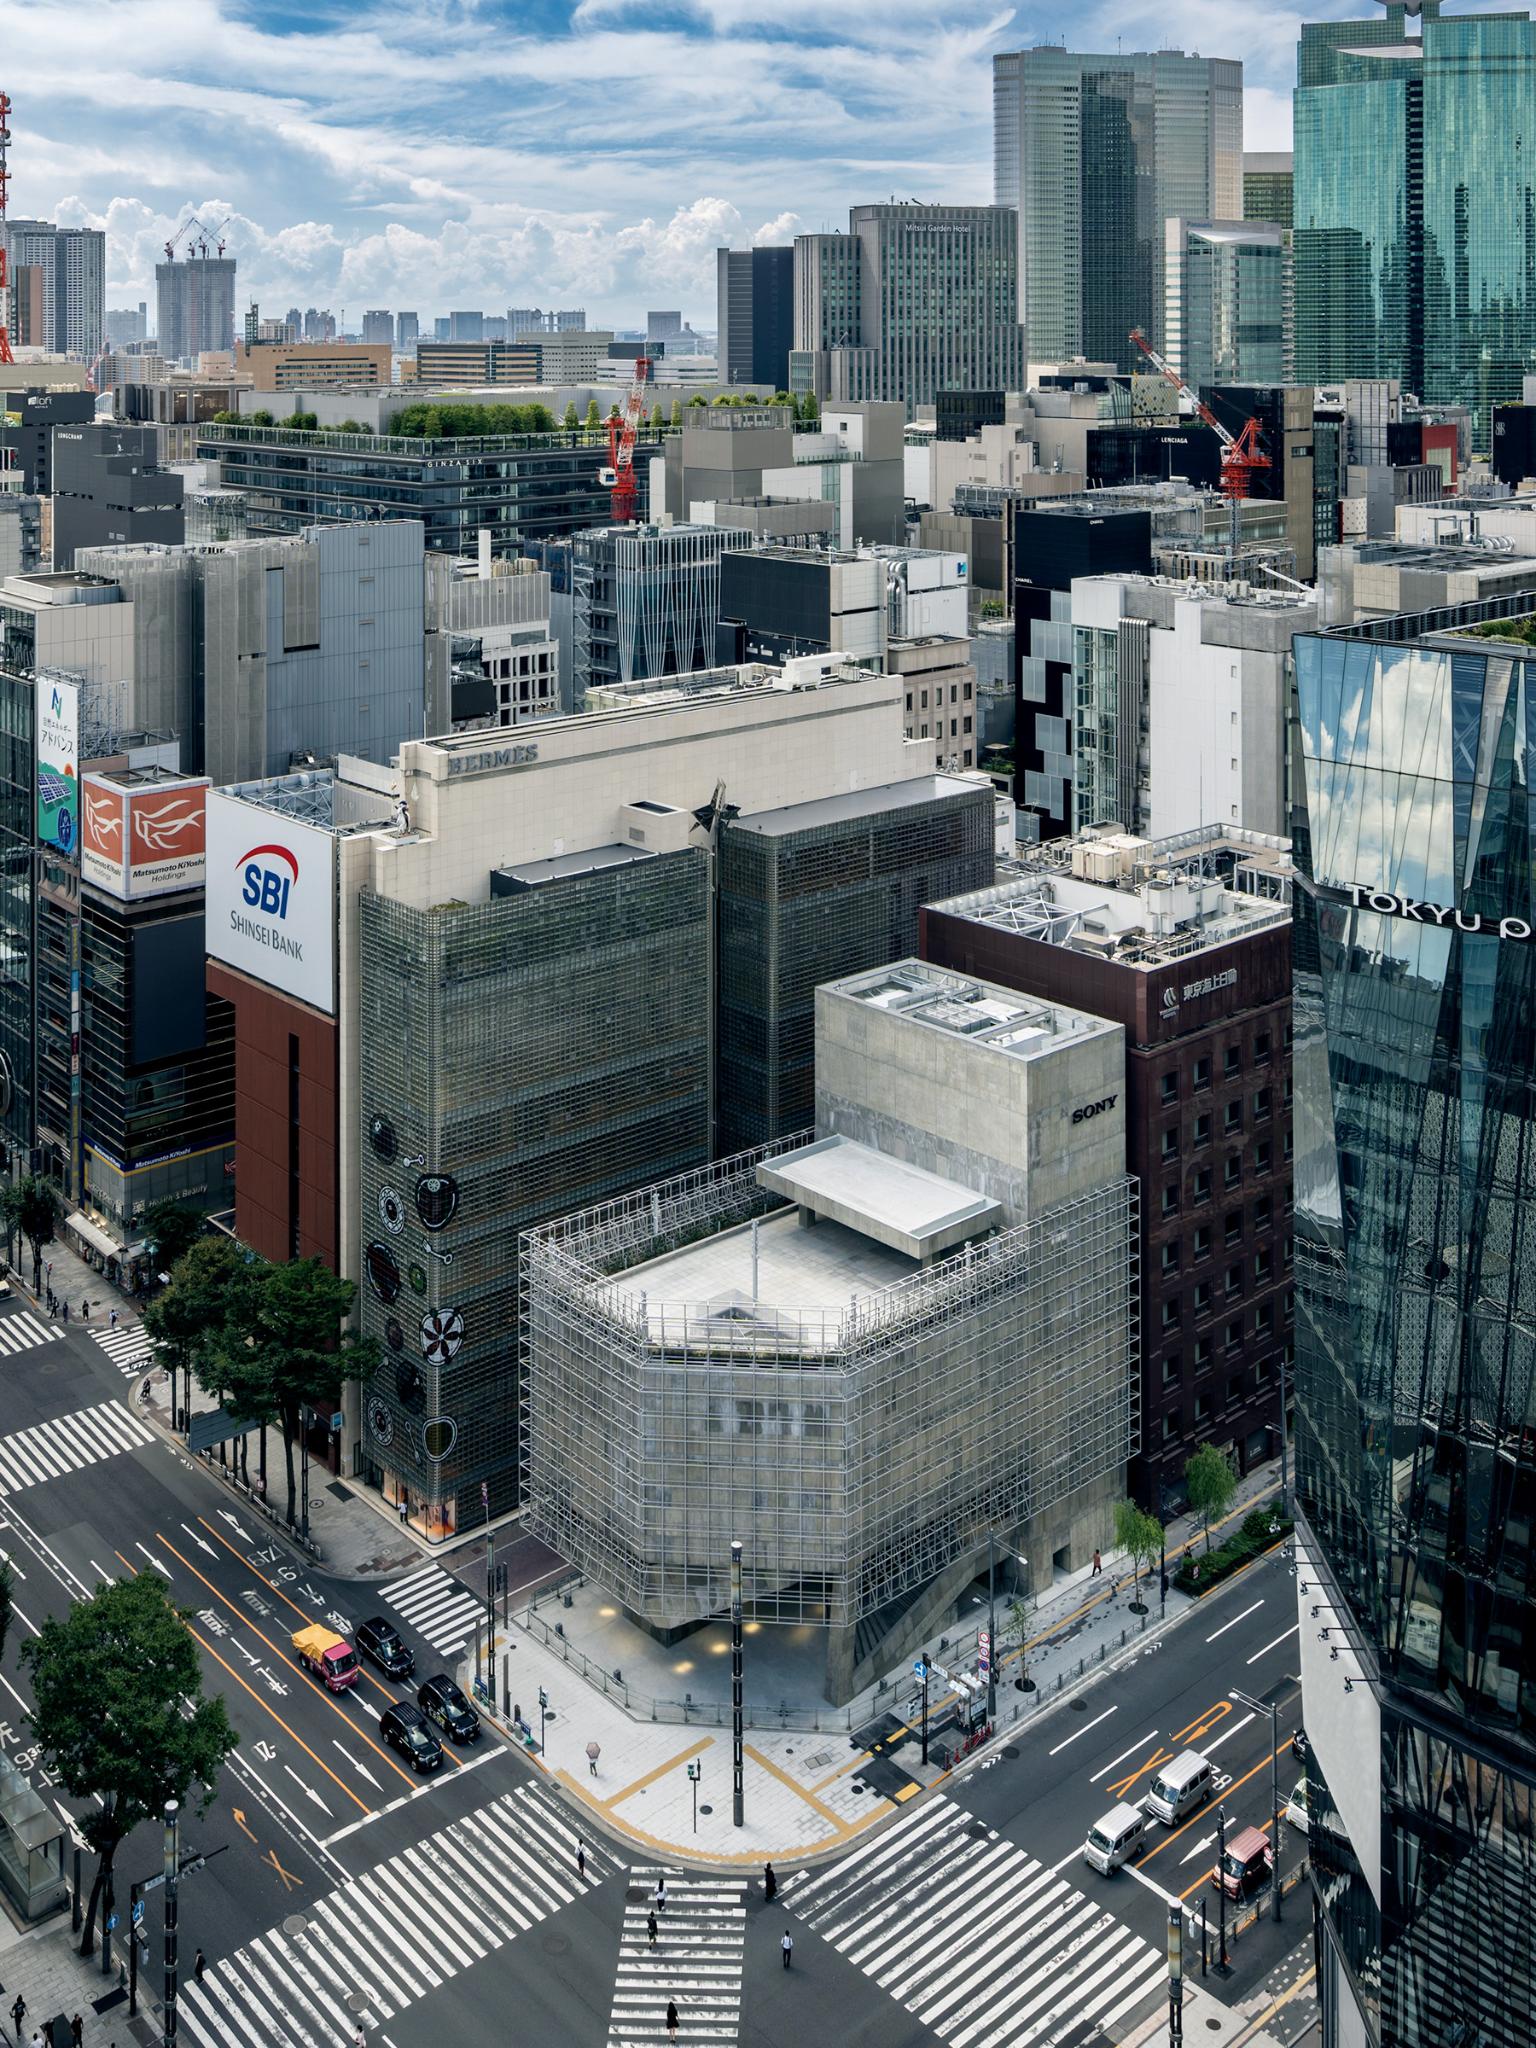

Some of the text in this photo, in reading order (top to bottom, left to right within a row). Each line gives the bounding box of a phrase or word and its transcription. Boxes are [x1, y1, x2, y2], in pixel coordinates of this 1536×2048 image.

[905, 224, 971, 232] Mitsui Garden Hotel
[427, 458, 483, 468] GINZA SIX
[41, 729, 74, 754] アドバンス
[132, 857, 206, 878] Matsumoto KiYoshi
[151, 871, 187, 883] Holdings
[242, 863, 291, 920] SBI
[1345, 883, 1481, 932] TOKYU
[230, 910, 304, 962] SHINSEI BANK
[1072, 1094, 1119, 1124] SONY
[134, 1155, 169, 1169] Matsumoto
[181, 1183, 209, 1199] Beauty
